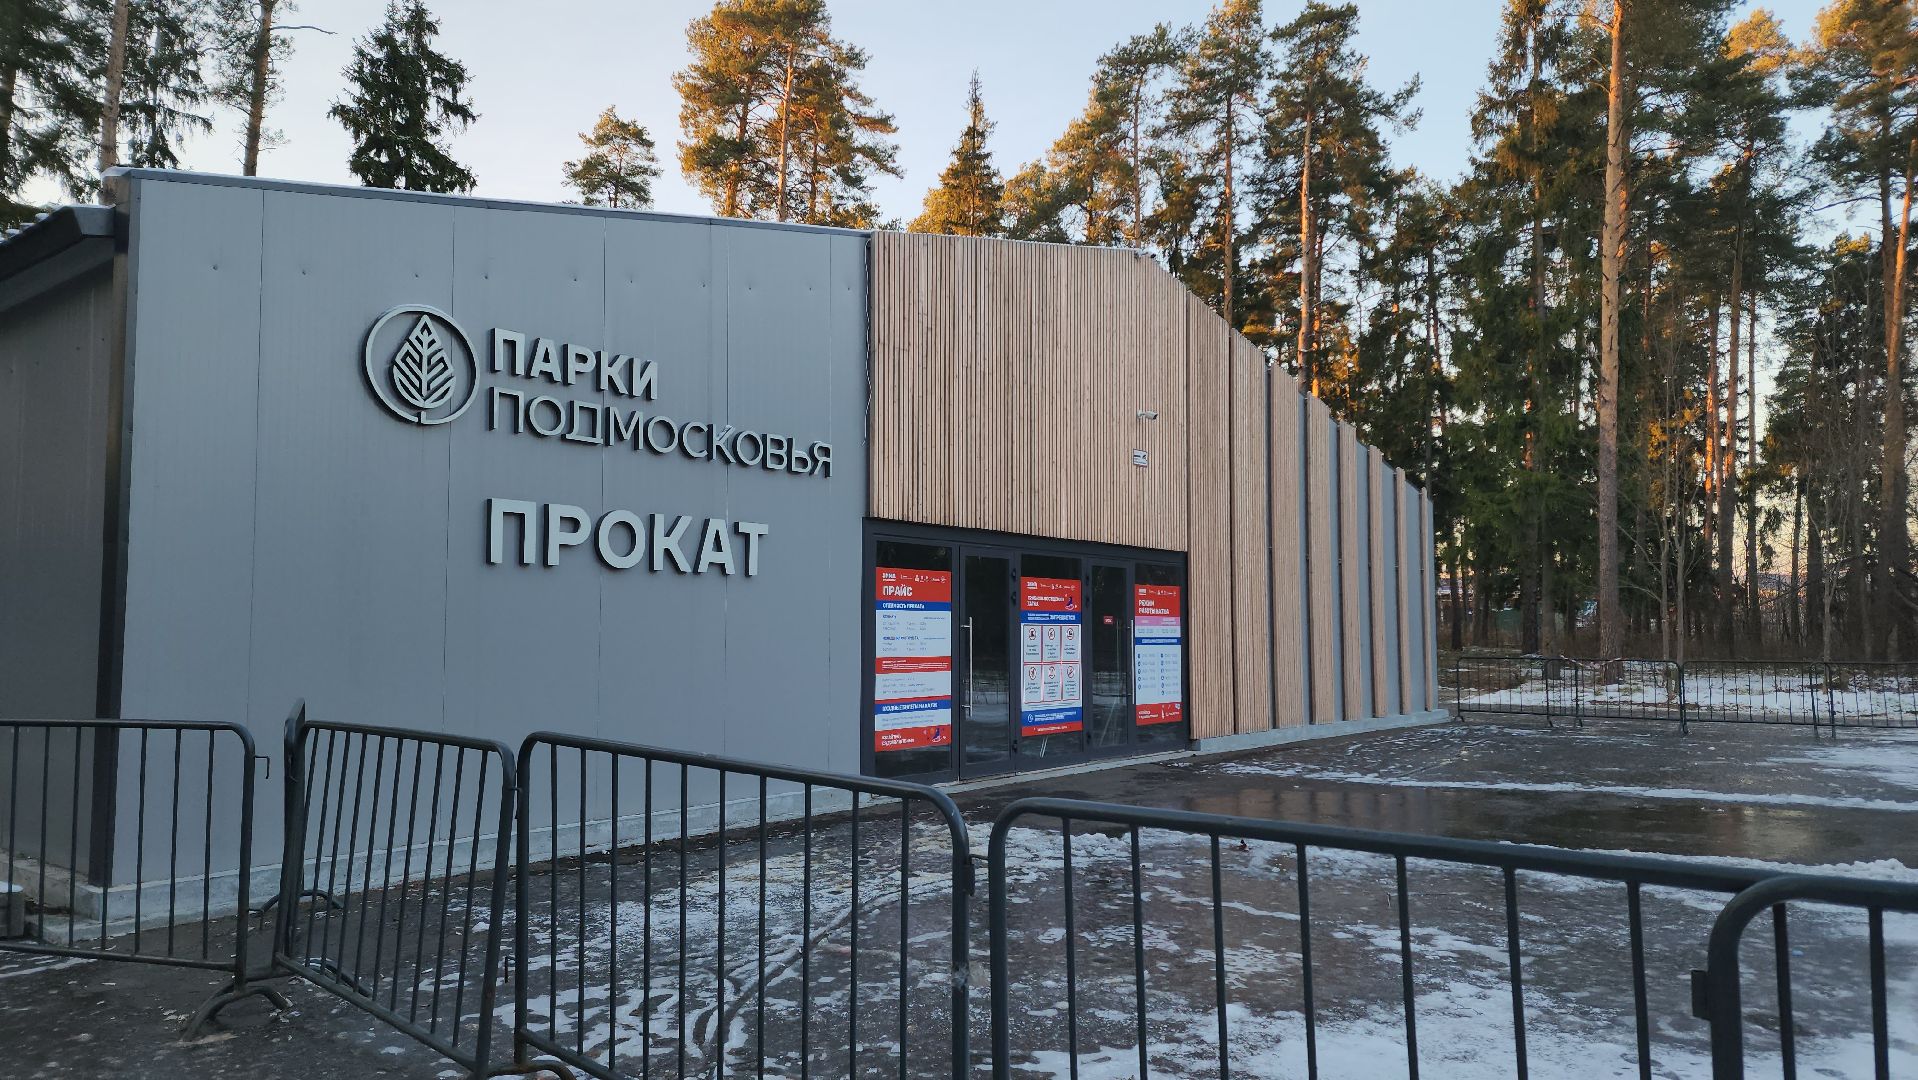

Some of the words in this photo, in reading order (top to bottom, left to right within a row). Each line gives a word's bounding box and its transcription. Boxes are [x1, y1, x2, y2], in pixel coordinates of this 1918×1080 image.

[489, 327, 659, 401] ПАРКИ
[488, 386, 833, 478] ПОДМОСКОВЬЯ
[486, 498, 769, 577] ПРОКАТ
[882, 584, 913, 597] ПРАЙС
